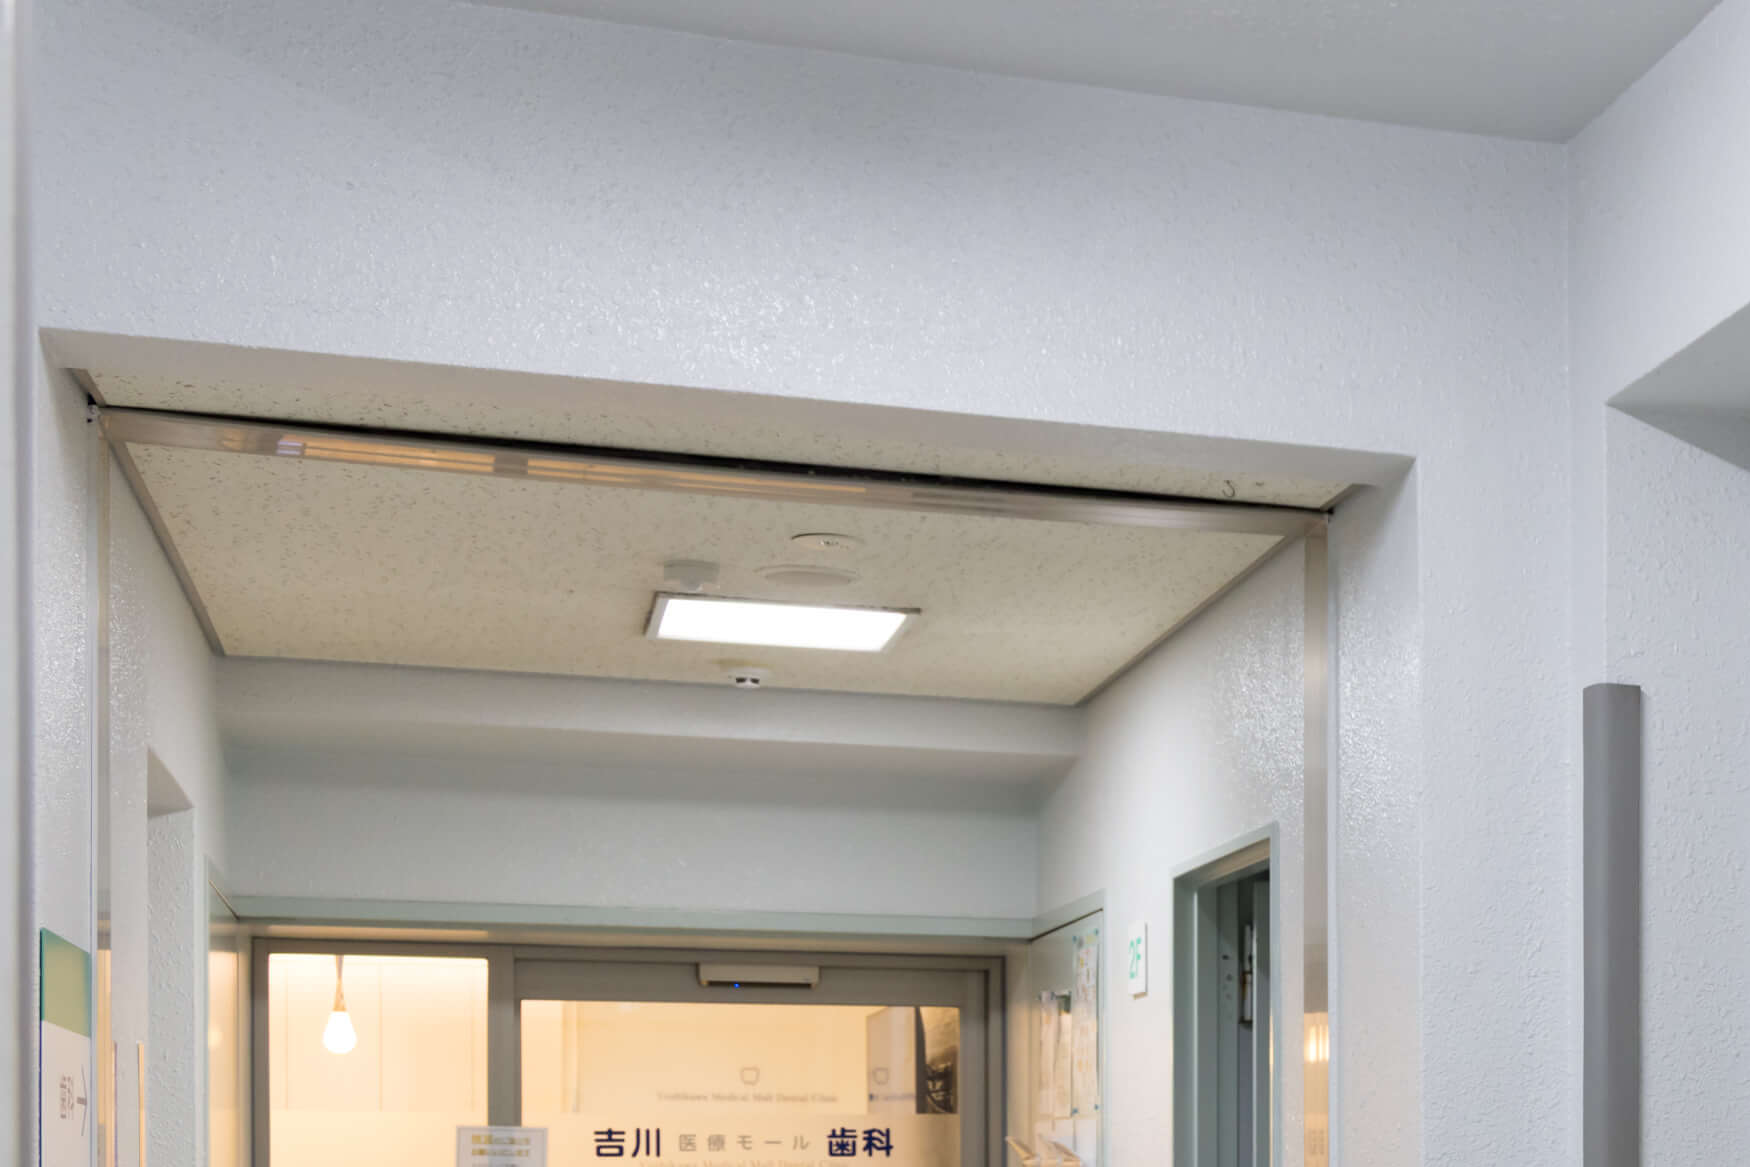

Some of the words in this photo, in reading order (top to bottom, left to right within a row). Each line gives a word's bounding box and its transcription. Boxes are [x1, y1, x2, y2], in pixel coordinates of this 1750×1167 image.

[593, 1127, 662, 1158] 吉川
[678, 1133, 811, 1153] 医療モール
[826, 1126, 894, 1158] 歯科
